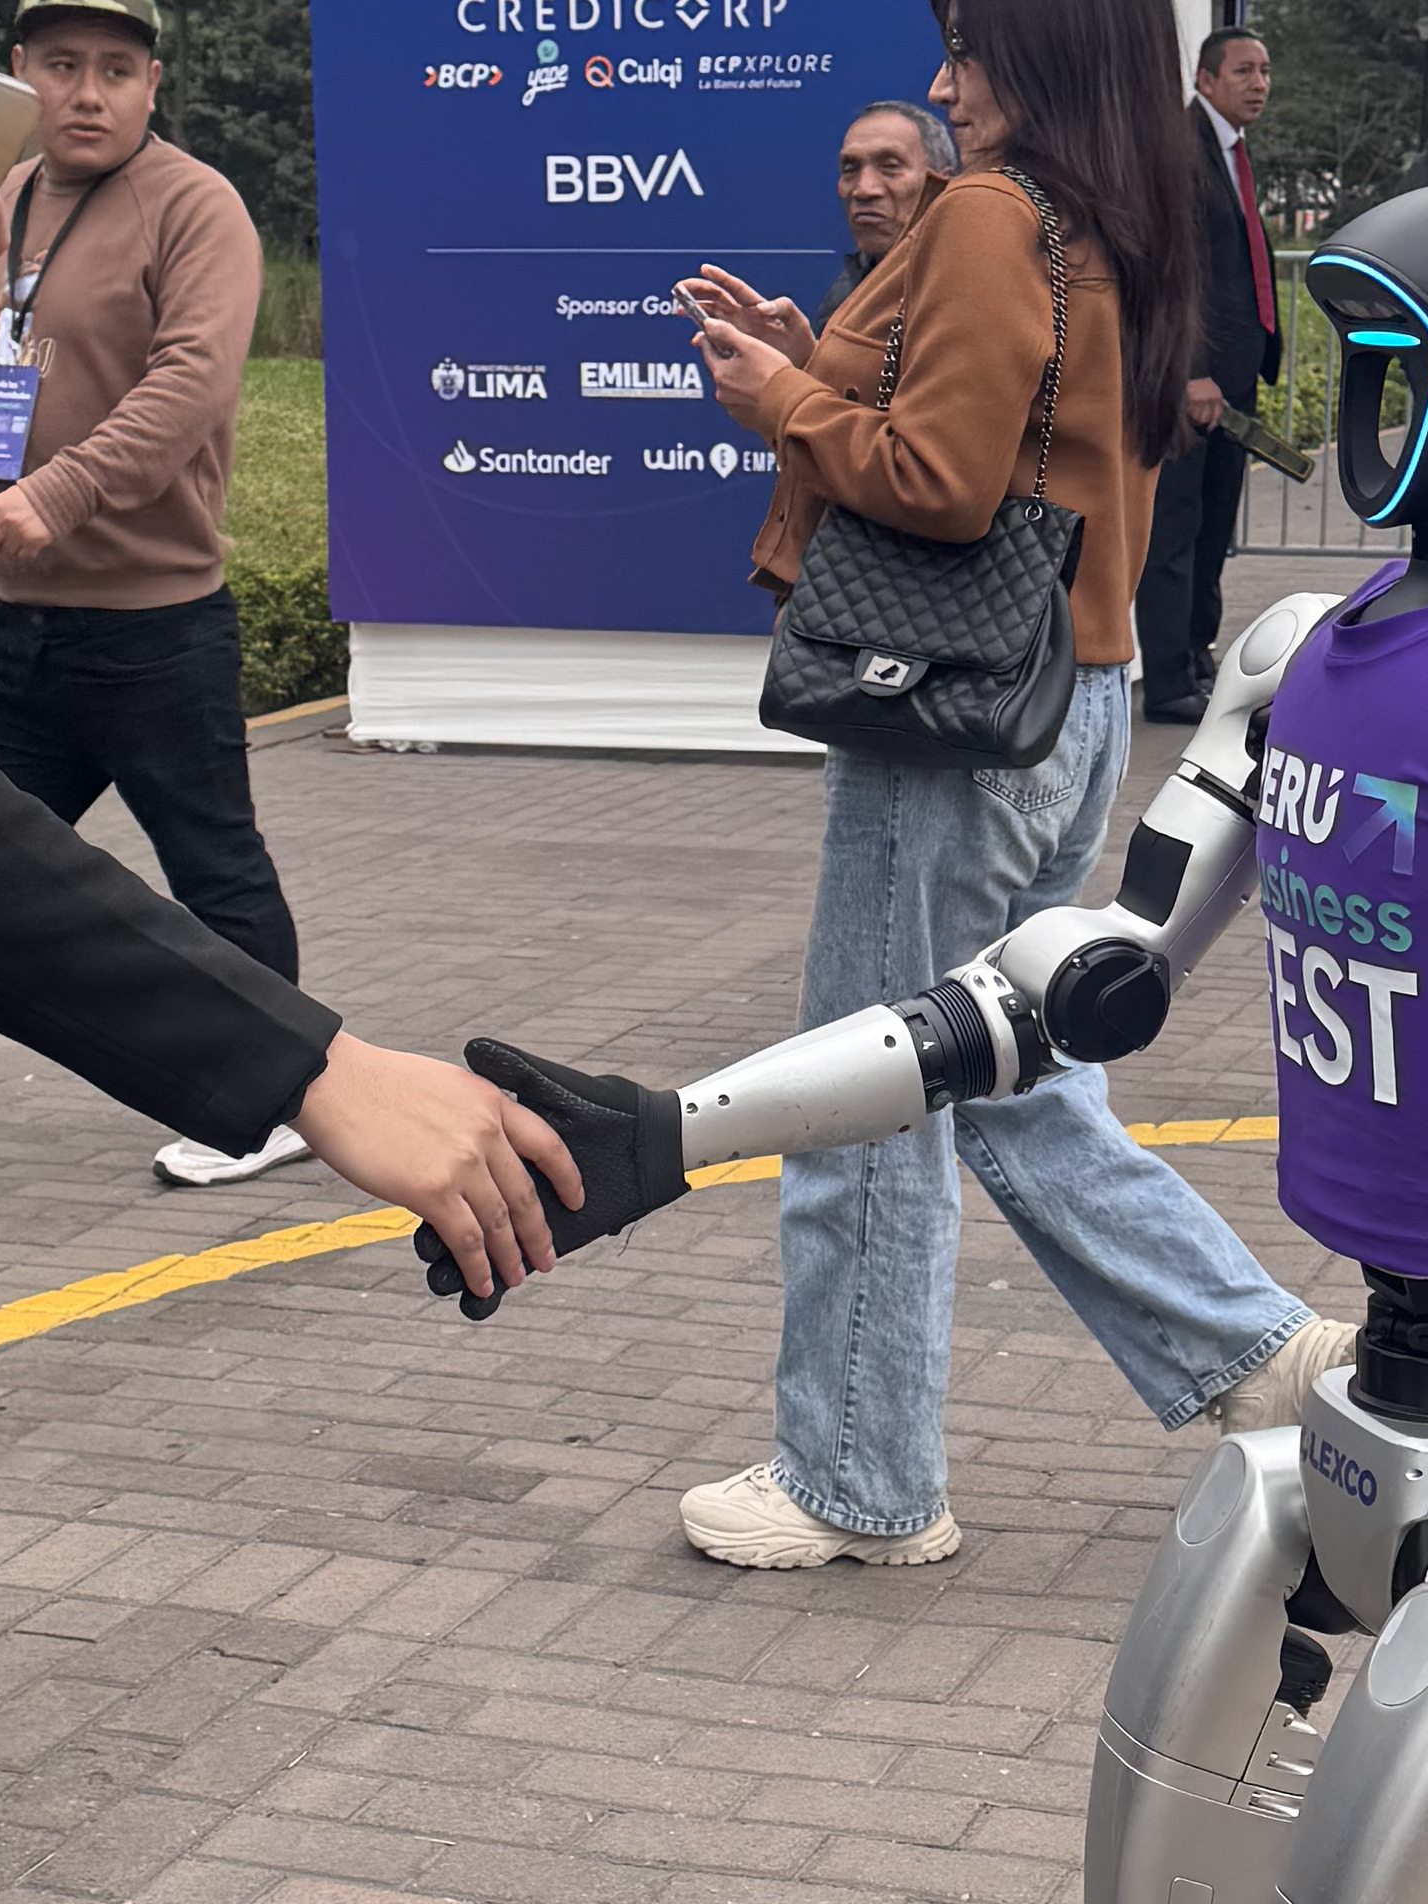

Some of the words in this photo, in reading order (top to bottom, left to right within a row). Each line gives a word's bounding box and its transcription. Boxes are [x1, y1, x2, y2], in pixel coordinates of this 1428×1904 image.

[438, 63, 490, 88] BCP
[618, 57, 682, 88] Culqi
[546, 149, 704, 202] BBVA
[556, 294, 640, 320] Sponsor
[642, 294, 684, 315] Gol
[468, 373, 547, 399] LIMA
[581, 361, 703, 388] EMILIMA
[479, 448, 611, 474] Santander
[643, 442, 704, 471] win
[743, 451, 780, 472] EMP
[1259, 747, 1344, 844] ERÚ
[1267, 918, 1418, 1105] EST
